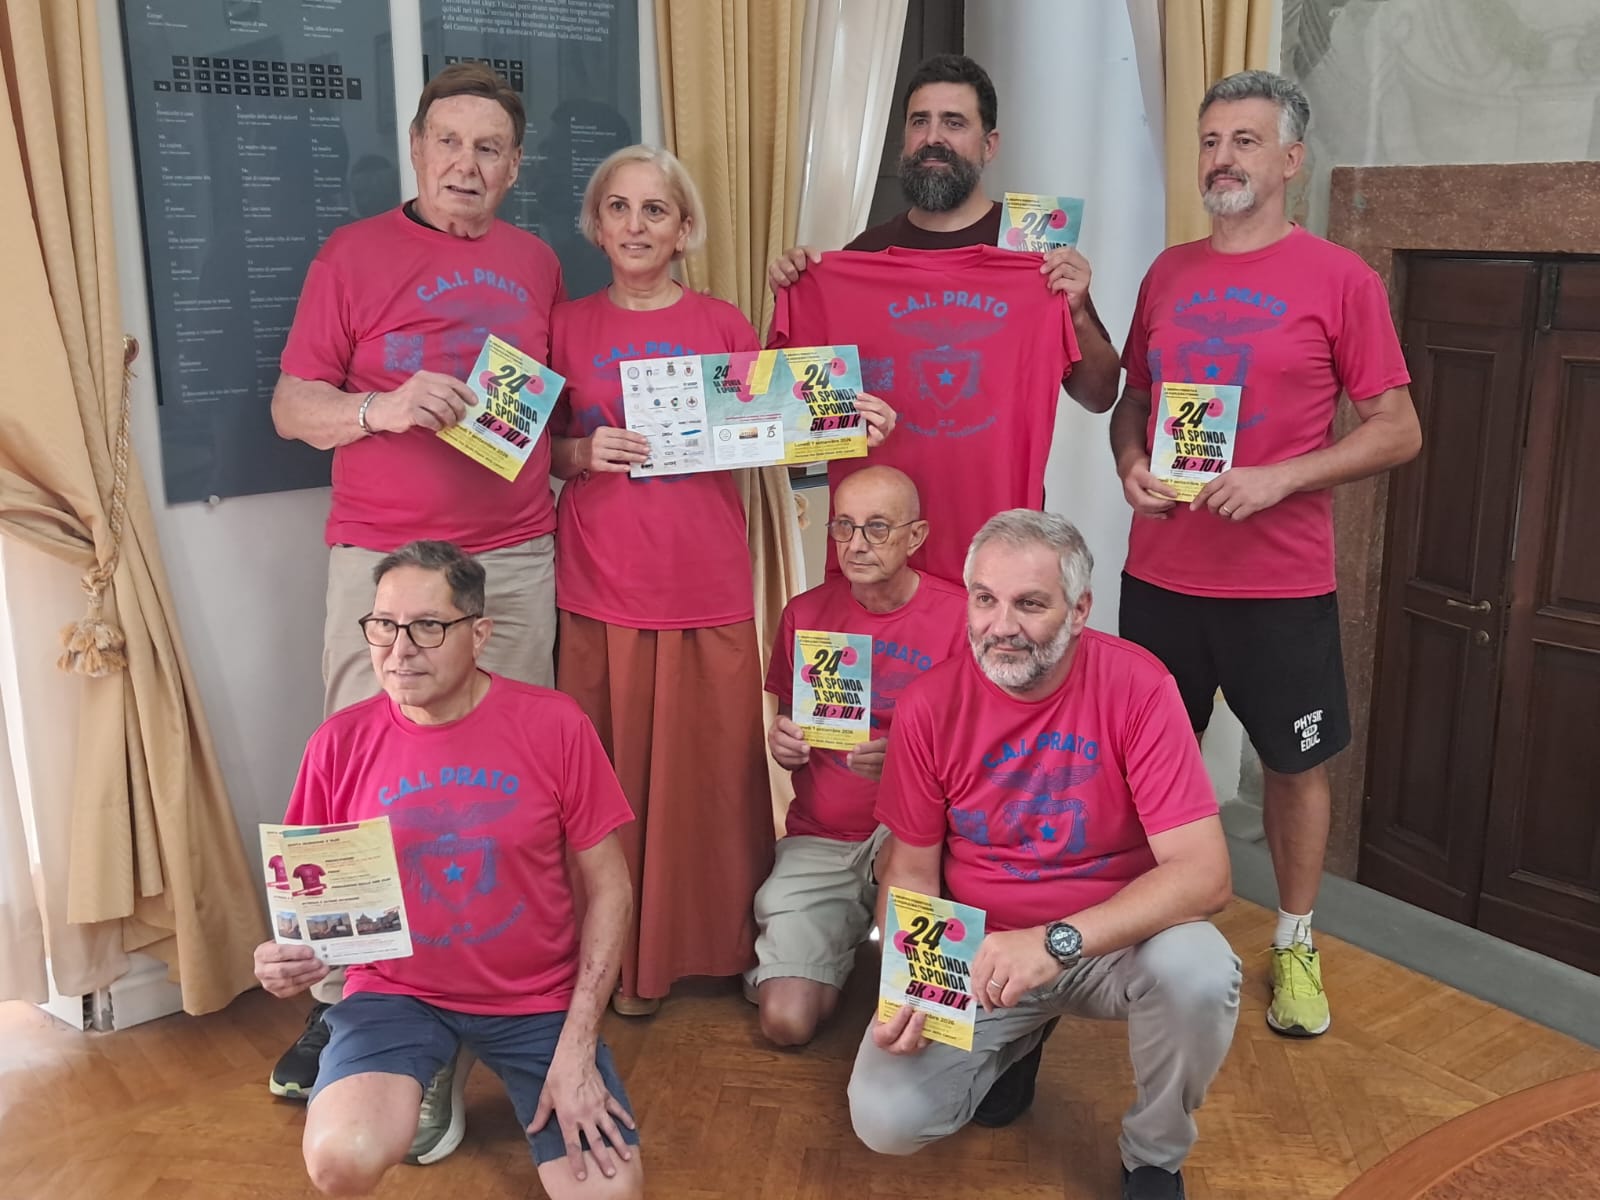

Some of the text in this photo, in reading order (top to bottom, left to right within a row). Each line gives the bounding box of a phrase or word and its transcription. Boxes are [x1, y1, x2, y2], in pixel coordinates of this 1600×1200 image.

[417, 268, 528, 302] C.A.I. PRATO
[888, 291, 1008, 318] C.A.I. PRATO
[1175, 286, 1287, 316] C.A.I. PRATO
[593, 343, 640, 368] C.A.I.
[487, 384, 537, 424] DA SPONDA
[802, 388, 858, 403] DA SPONDA
[809, 402, 856, 416] A SPONDA
[476, 412, 532, 449] 5K 10 K
[486, 398, 530, 435] A SPONDA
[810, 417, 827, 431] 5K
[837, 416, 850, 429] 10
[1172, 428, 1227, 444] DA SPONDA
[1176, 443, 1223, 458] A SPONDA
[1172, 457, 1227, 473] 5K 10 K
[874, 640, 932, 671] PRATO
[809, 676, 864, 692] DA SPONDA
[814, 690, 862, 705] A SPONDA
[813, 704, 866, 720] 5K 10 K
[983, 732, 1098, 769] C.A.I. PRATO
[379, 766, 519, 806] C.A.I. PRATO
[904, 945, 970, 977] DA SPONDA
[909, 963, 967, 992] A SPONDA
[905, 981, 972, 1011] 5K 10 K
